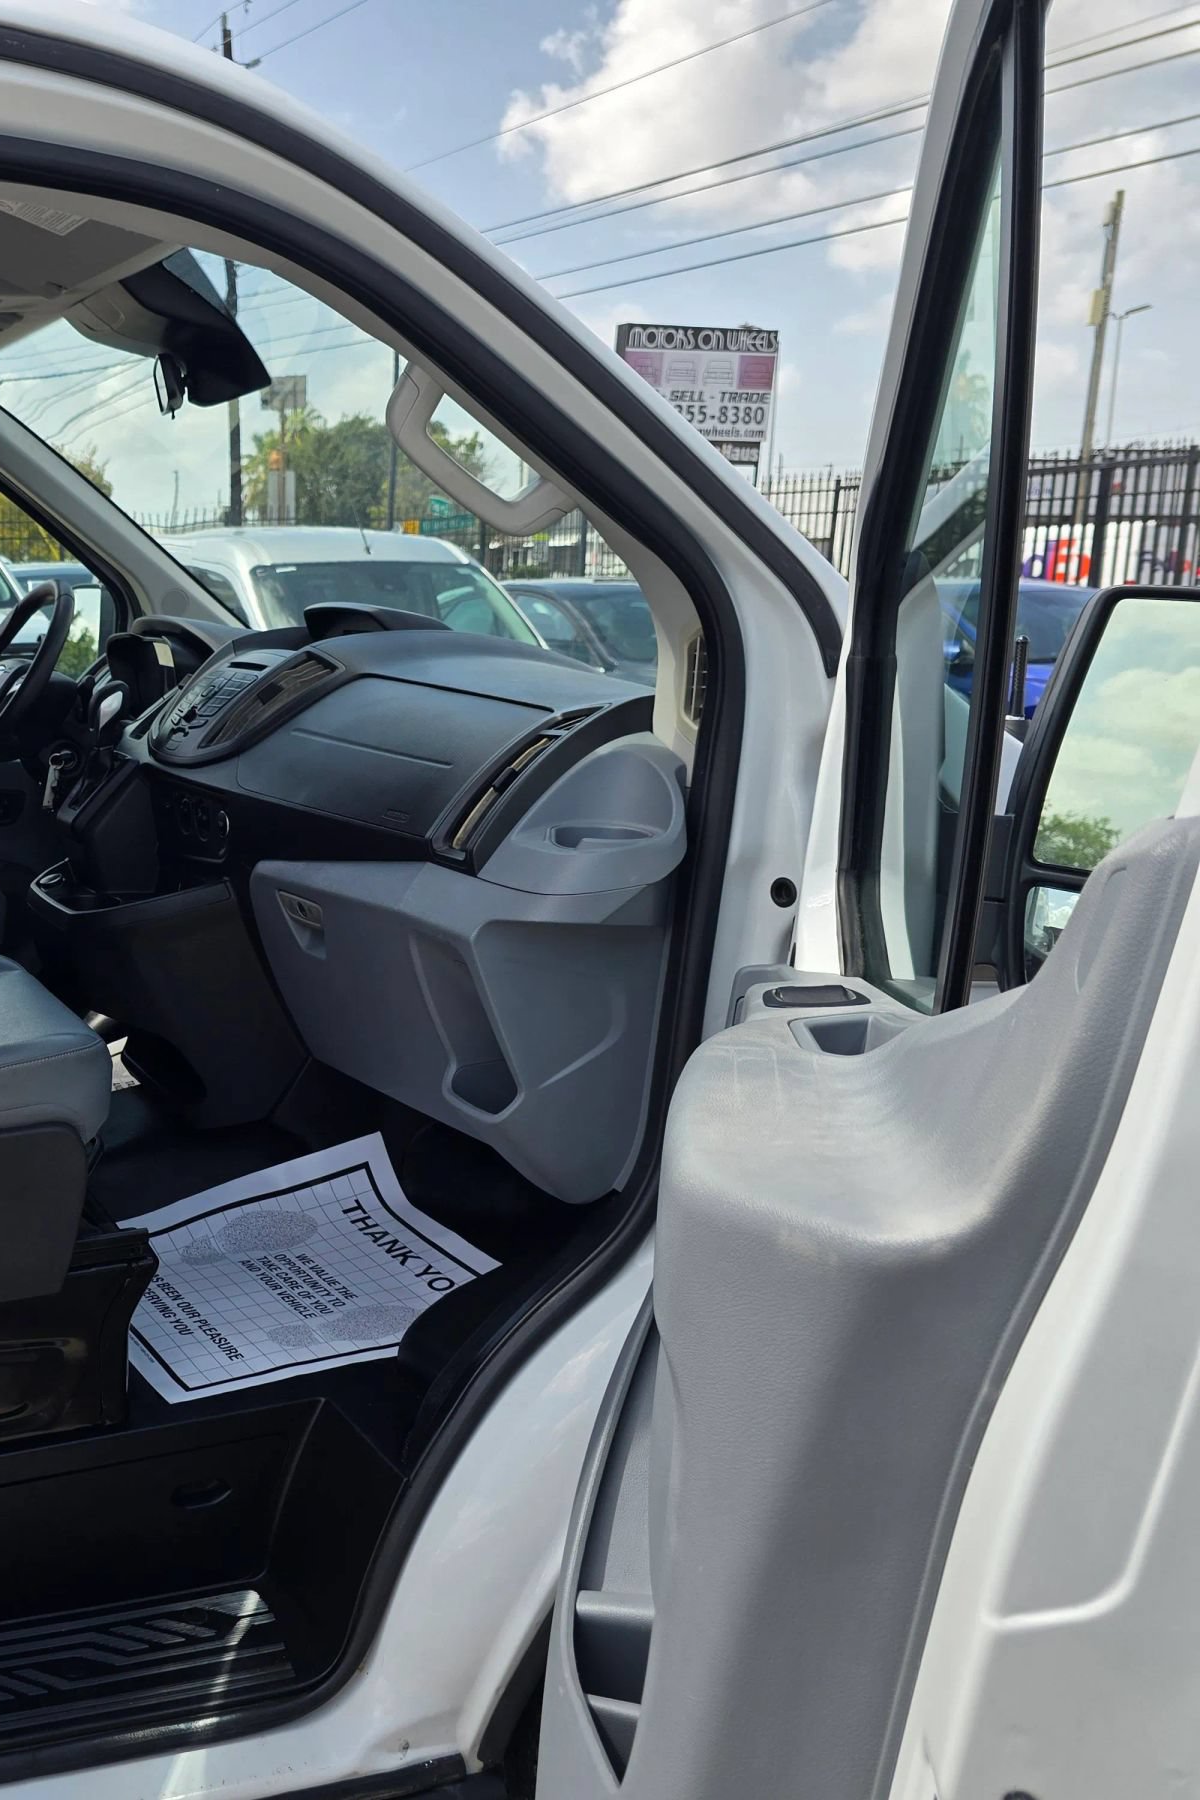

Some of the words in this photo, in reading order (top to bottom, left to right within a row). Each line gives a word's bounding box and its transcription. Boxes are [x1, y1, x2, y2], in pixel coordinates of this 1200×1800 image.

[629, 327, 696, 350] MOTORS
[726, 330, 779, 353] WHEELS
[669, 390, 705, 403] SELL
[718, 391, 771, 404] TRADE
[341, 1199, 424, 1266] THANK
[414, 1263, 455, 1291] YO
[238, 1259, 262, 1273] AND
[255, 1271, 283, 1292] YOUR
[276, 1290, 318, 1320] VEHICLE
[256, 1255, 281, 1273] TAKE
[275, 1271, 301, 1290] CARE
[297, 1289, 314, 1300] OF
[311, 1297, 335, 1315] YOU
[273, 1253, 335, 1298] OPPORTUNITY
[328, 1297, 346, 1308] TO
[294, 1253, 314, 1266] WE
[310, 1264, 340, 1287] VALUE
[336, 1285, 359, 1300] THE
[156, 1282, 185, 1301] BEEN
[176, 1300, 201, 1320] OUR
[196, 1318, 246, 1362] PLEASURE
[169, 1318, 195, 1336] YOU
